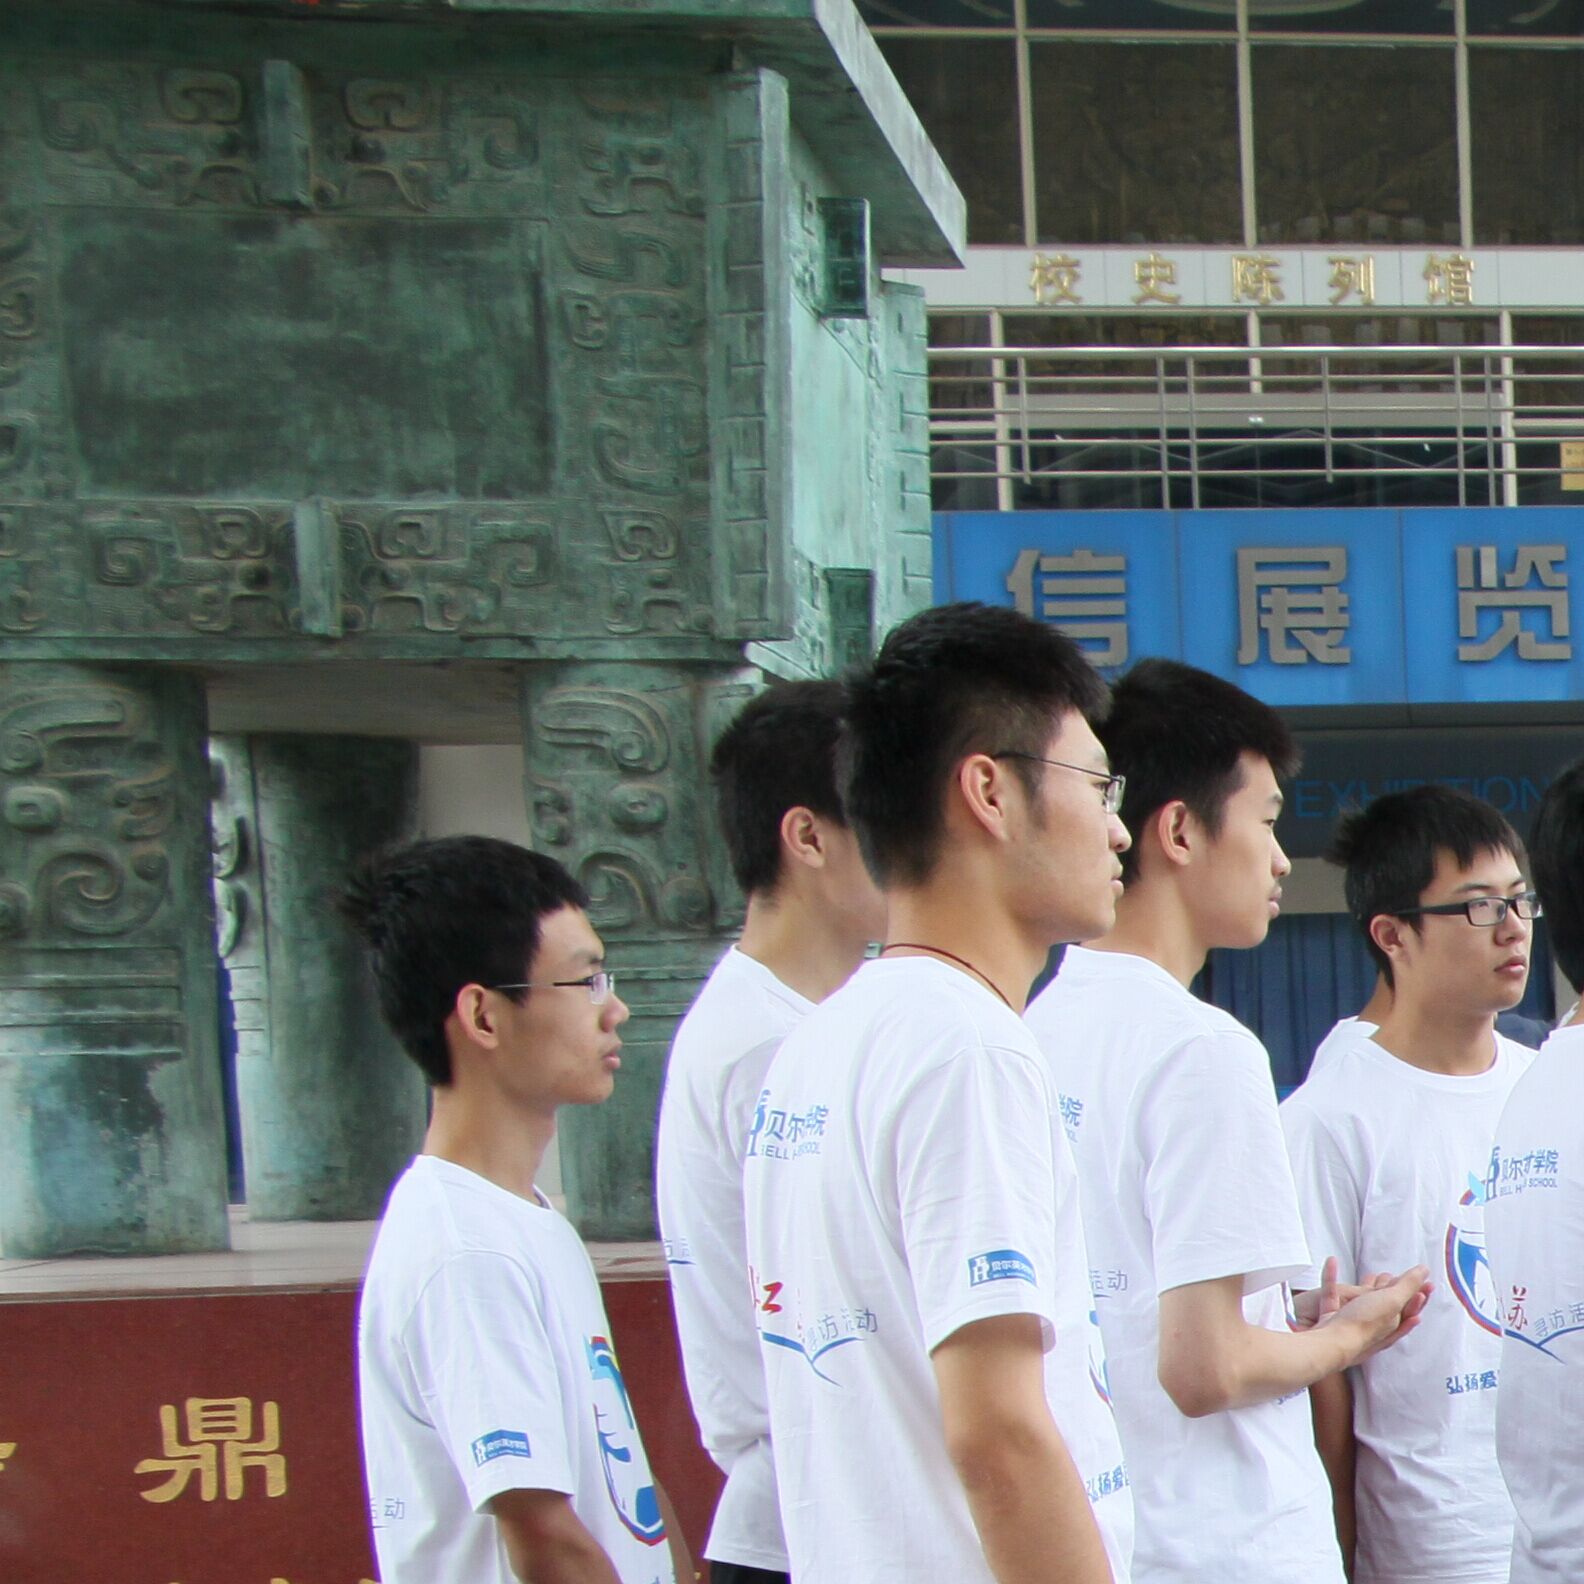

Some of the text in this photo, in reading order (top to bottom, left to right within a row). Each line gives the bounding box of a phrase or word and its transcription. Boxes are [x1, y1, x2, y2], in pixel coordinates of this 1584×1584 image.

[1028, 251, 1477, 308] 校史陈列馆
[1445, 1369, 1500, 1395] 弘扬爱
